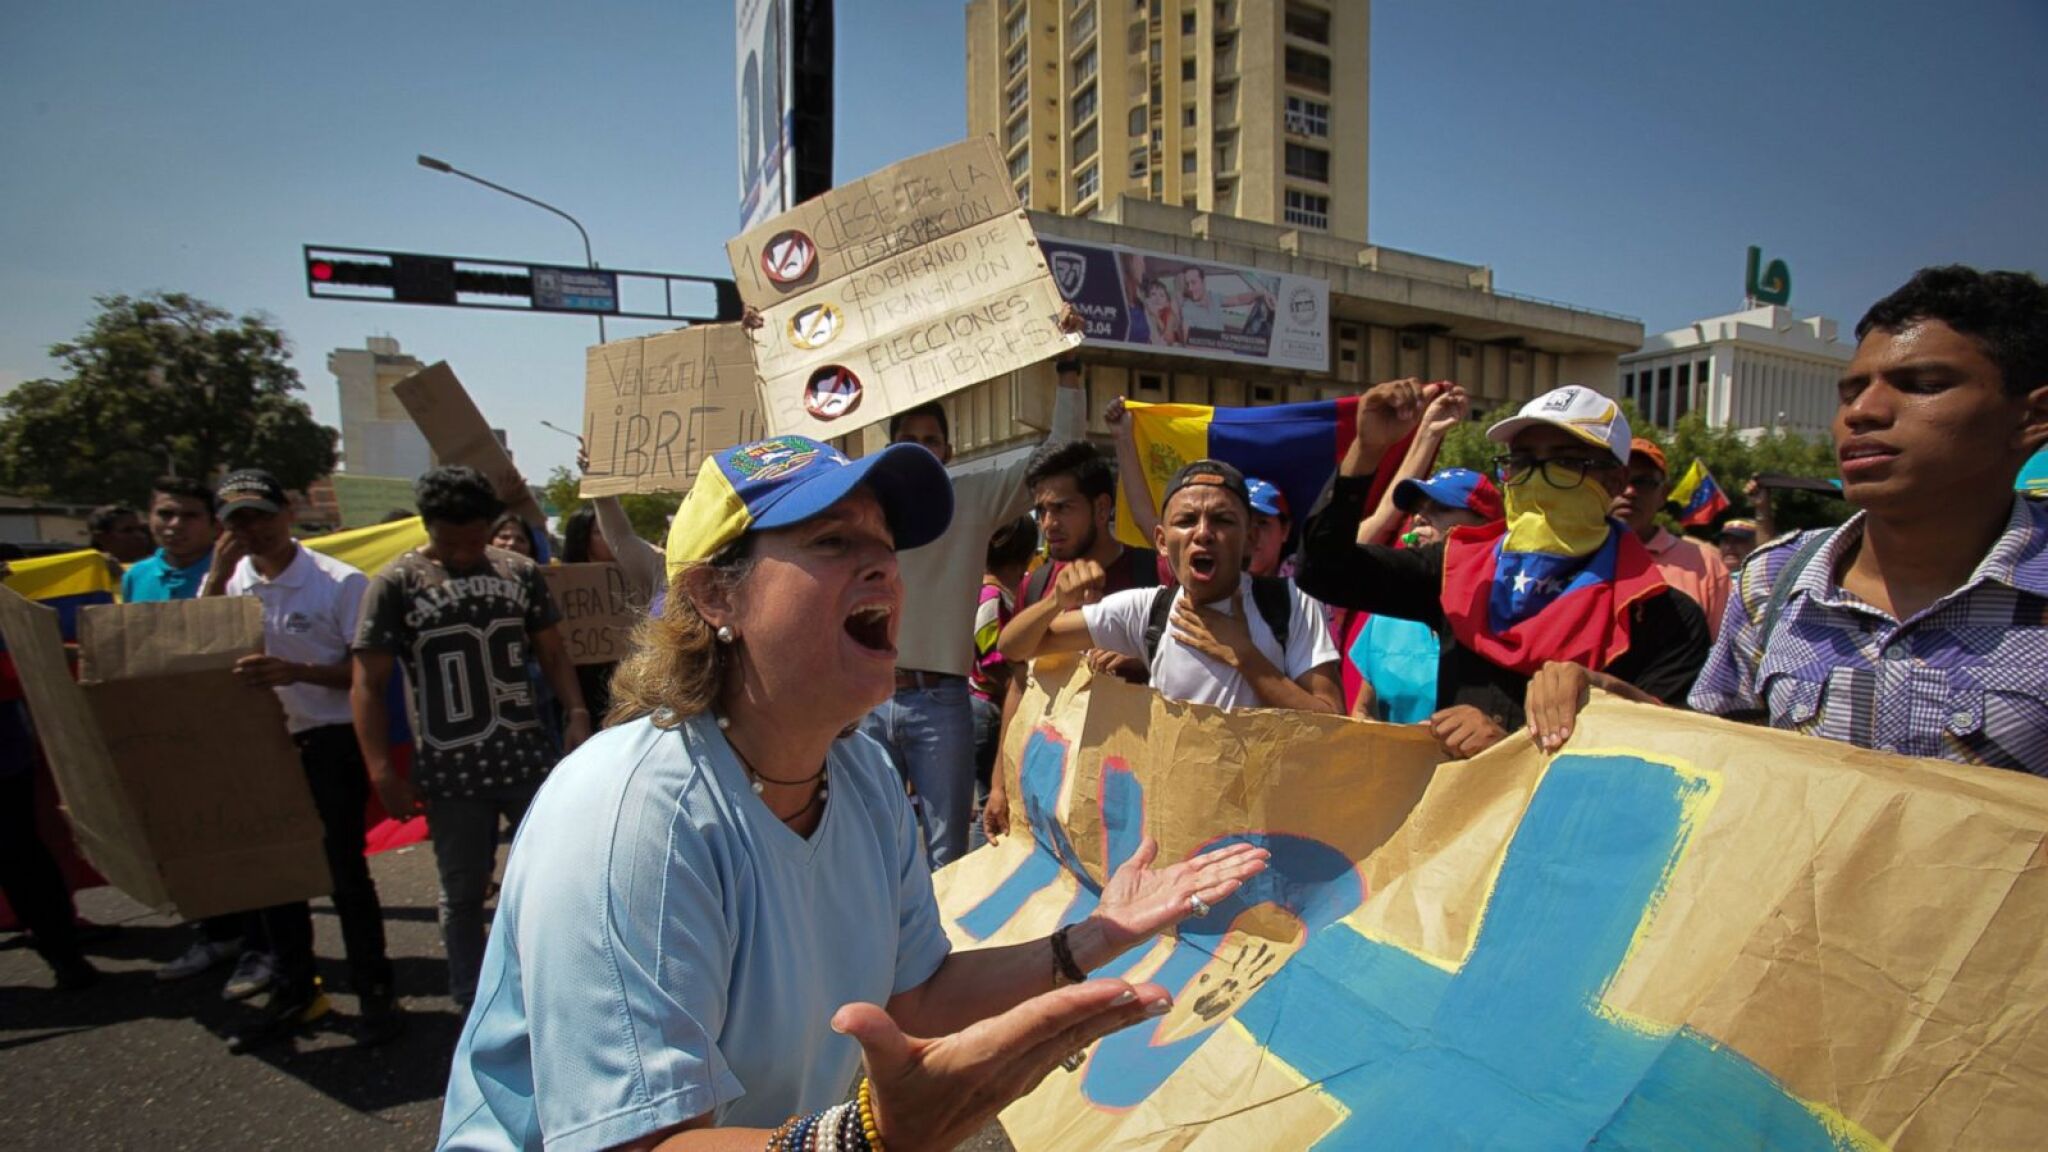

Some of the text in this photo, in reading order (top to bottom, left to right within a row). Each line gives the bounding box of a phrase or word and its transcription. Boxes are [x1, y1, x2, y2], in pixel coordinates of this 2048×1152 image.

[813, 189, 897, 251] CESE
[948, 164, 992, 193] LA
[840, 226, 1006, 303] GOBIERNO DE
[866, 293, 1031, 374] ELECCIONES
[904, 318, 1052, 394] LIBRES
[405, 575, 530, 628] CALIFORNI
